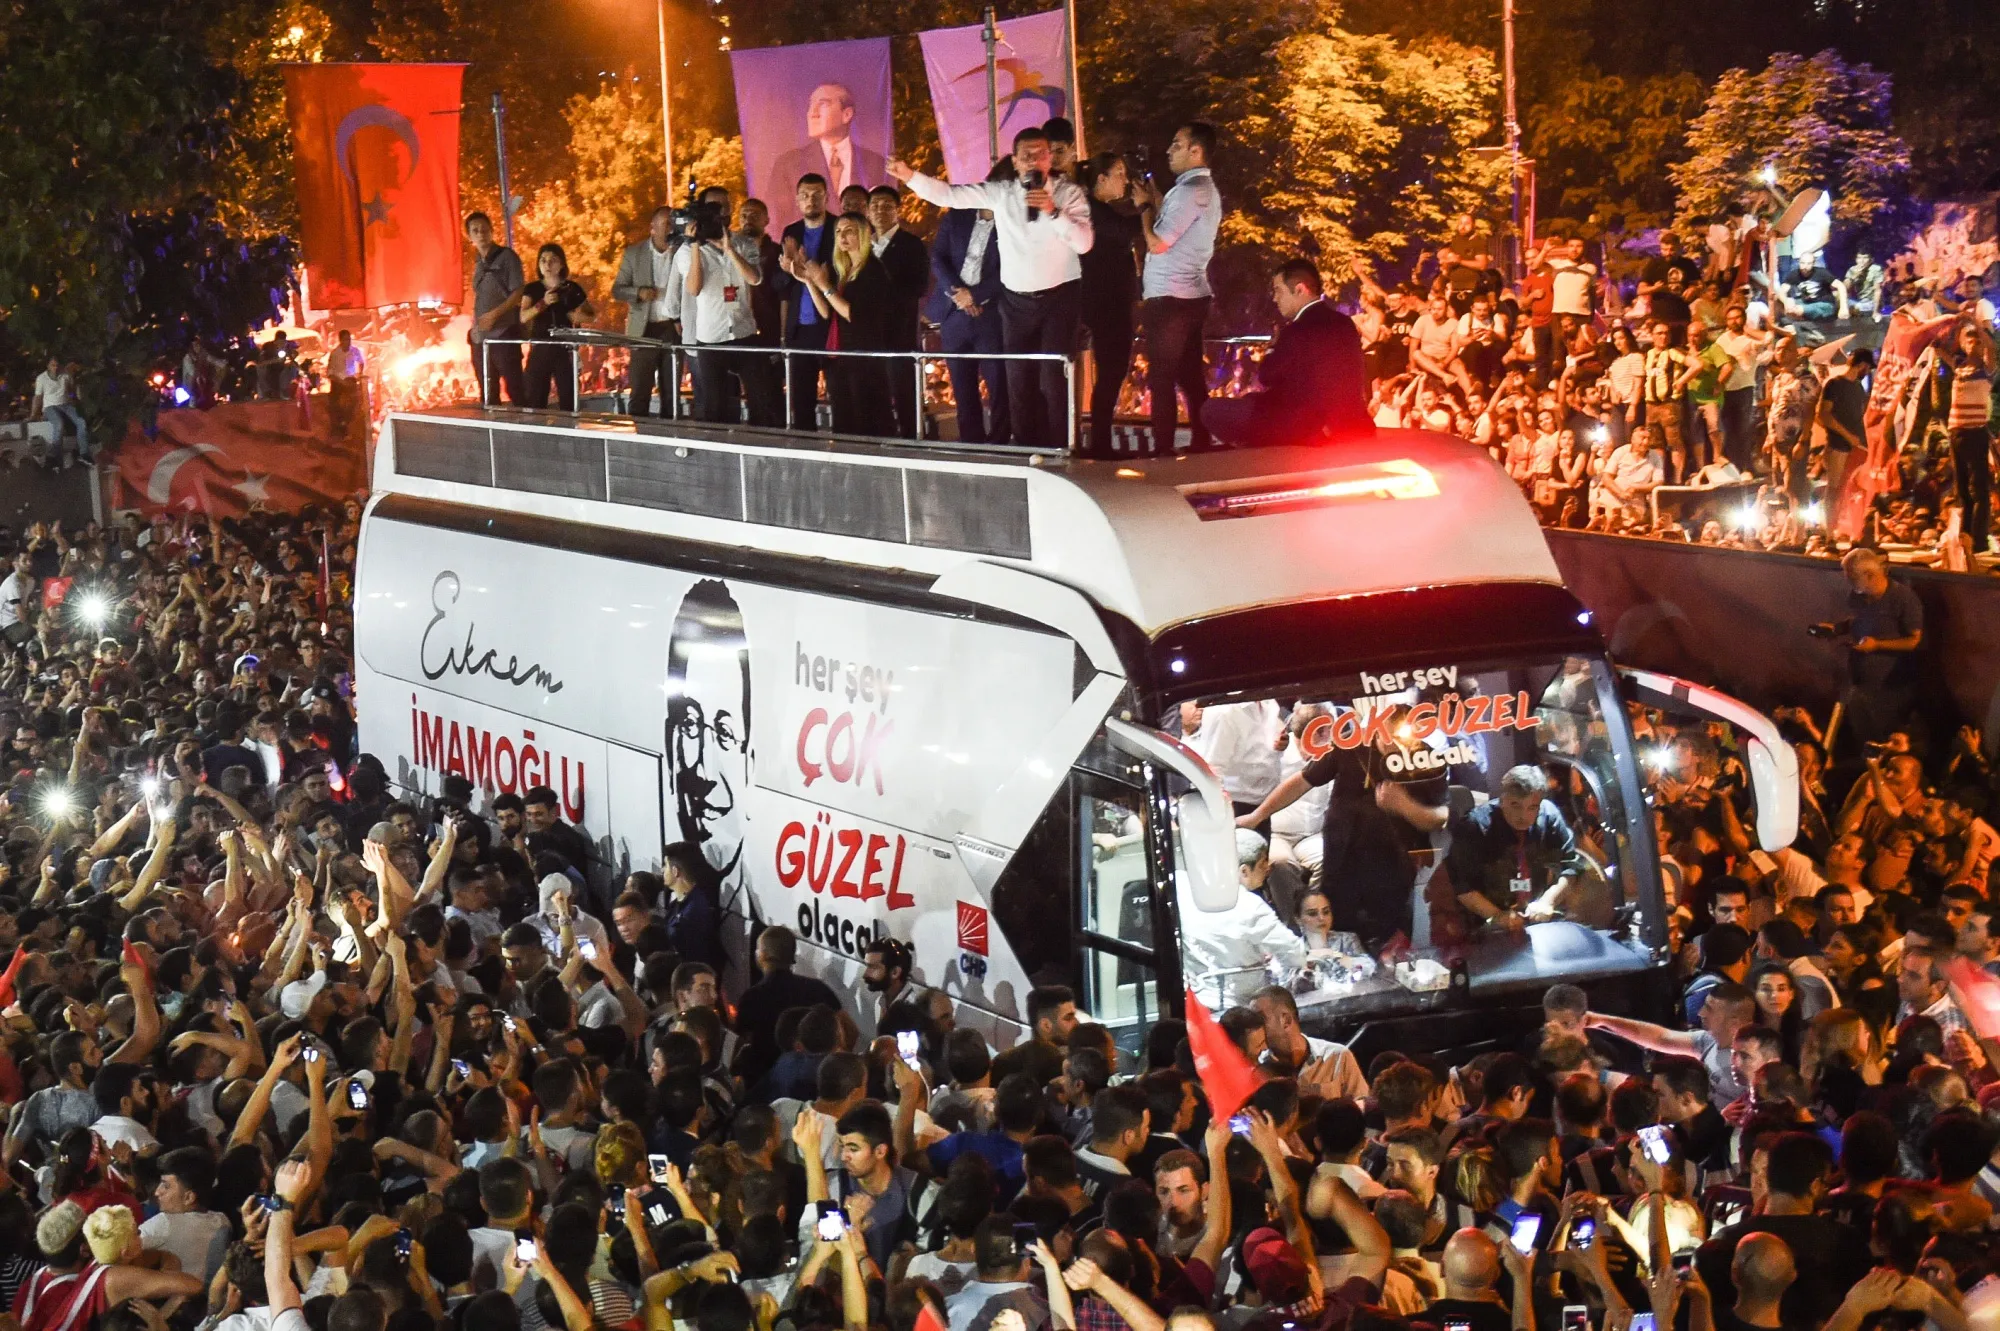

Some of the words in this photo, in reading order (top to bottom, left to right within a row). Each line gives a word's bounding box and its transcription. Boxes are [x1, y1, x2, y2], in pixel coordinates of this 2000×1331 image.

[420, 569, 563, 694] Ekrem
[795, 640, 840, 693] her
[845, 661, 894, 716] şey
[1359, 670, 1409, 695] her
[1412, 665, 1458, 691] şey
[411, 692, 585, 824] İMAMOĞLU
[796, 706, 895, 797] ÇOK
[1300, 703, 1397, 763] ÇOK
[1406, 689, 1543, 740] GÜZEL
[1385, 740, 1479, 774] olacak
[775, 811, 916, 911] GÜZEL
[959, 952, 988, 979] CHP
